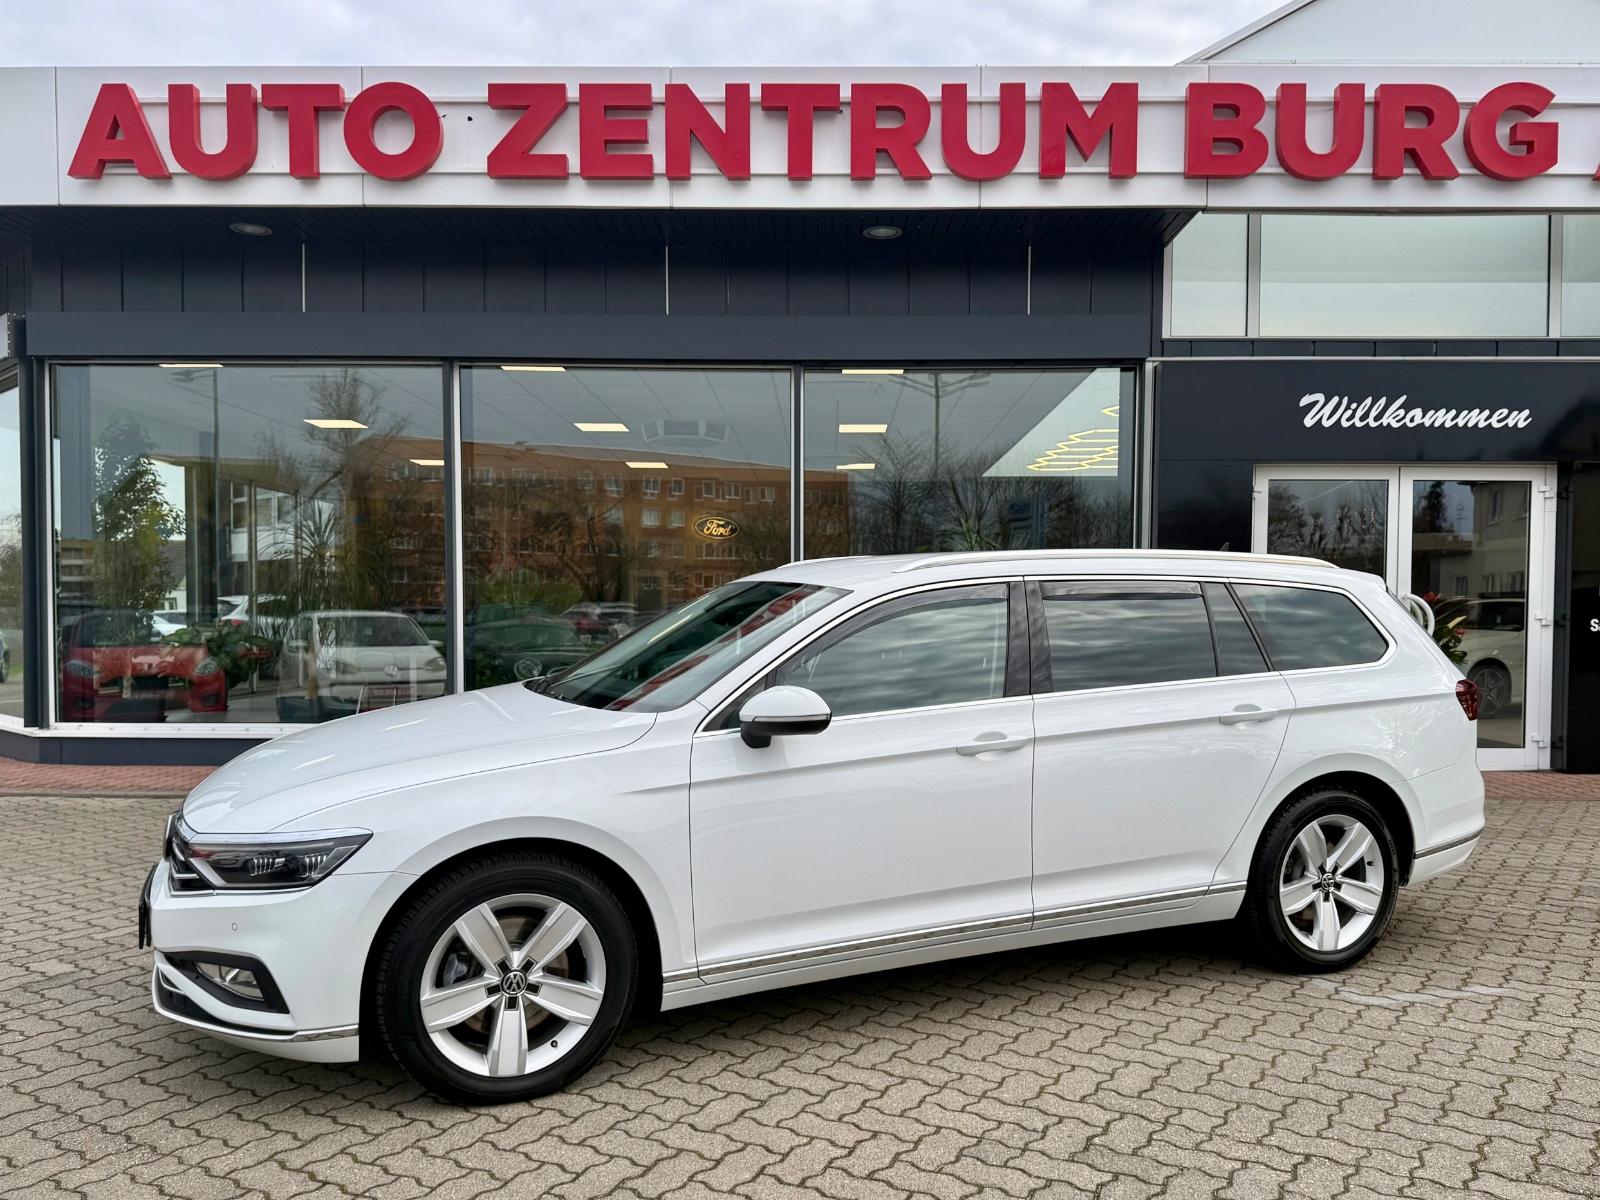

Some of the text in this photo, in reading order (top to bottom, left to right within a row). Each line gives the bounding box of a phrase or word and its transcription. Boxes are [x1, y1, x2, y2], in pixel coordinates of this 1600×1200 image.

[68, 81, 1560, 182] AUTO ZENTRUM BURG
[1299, 392, 1533, 429] Willkommen
[703, 519, 732, 536] Ford
